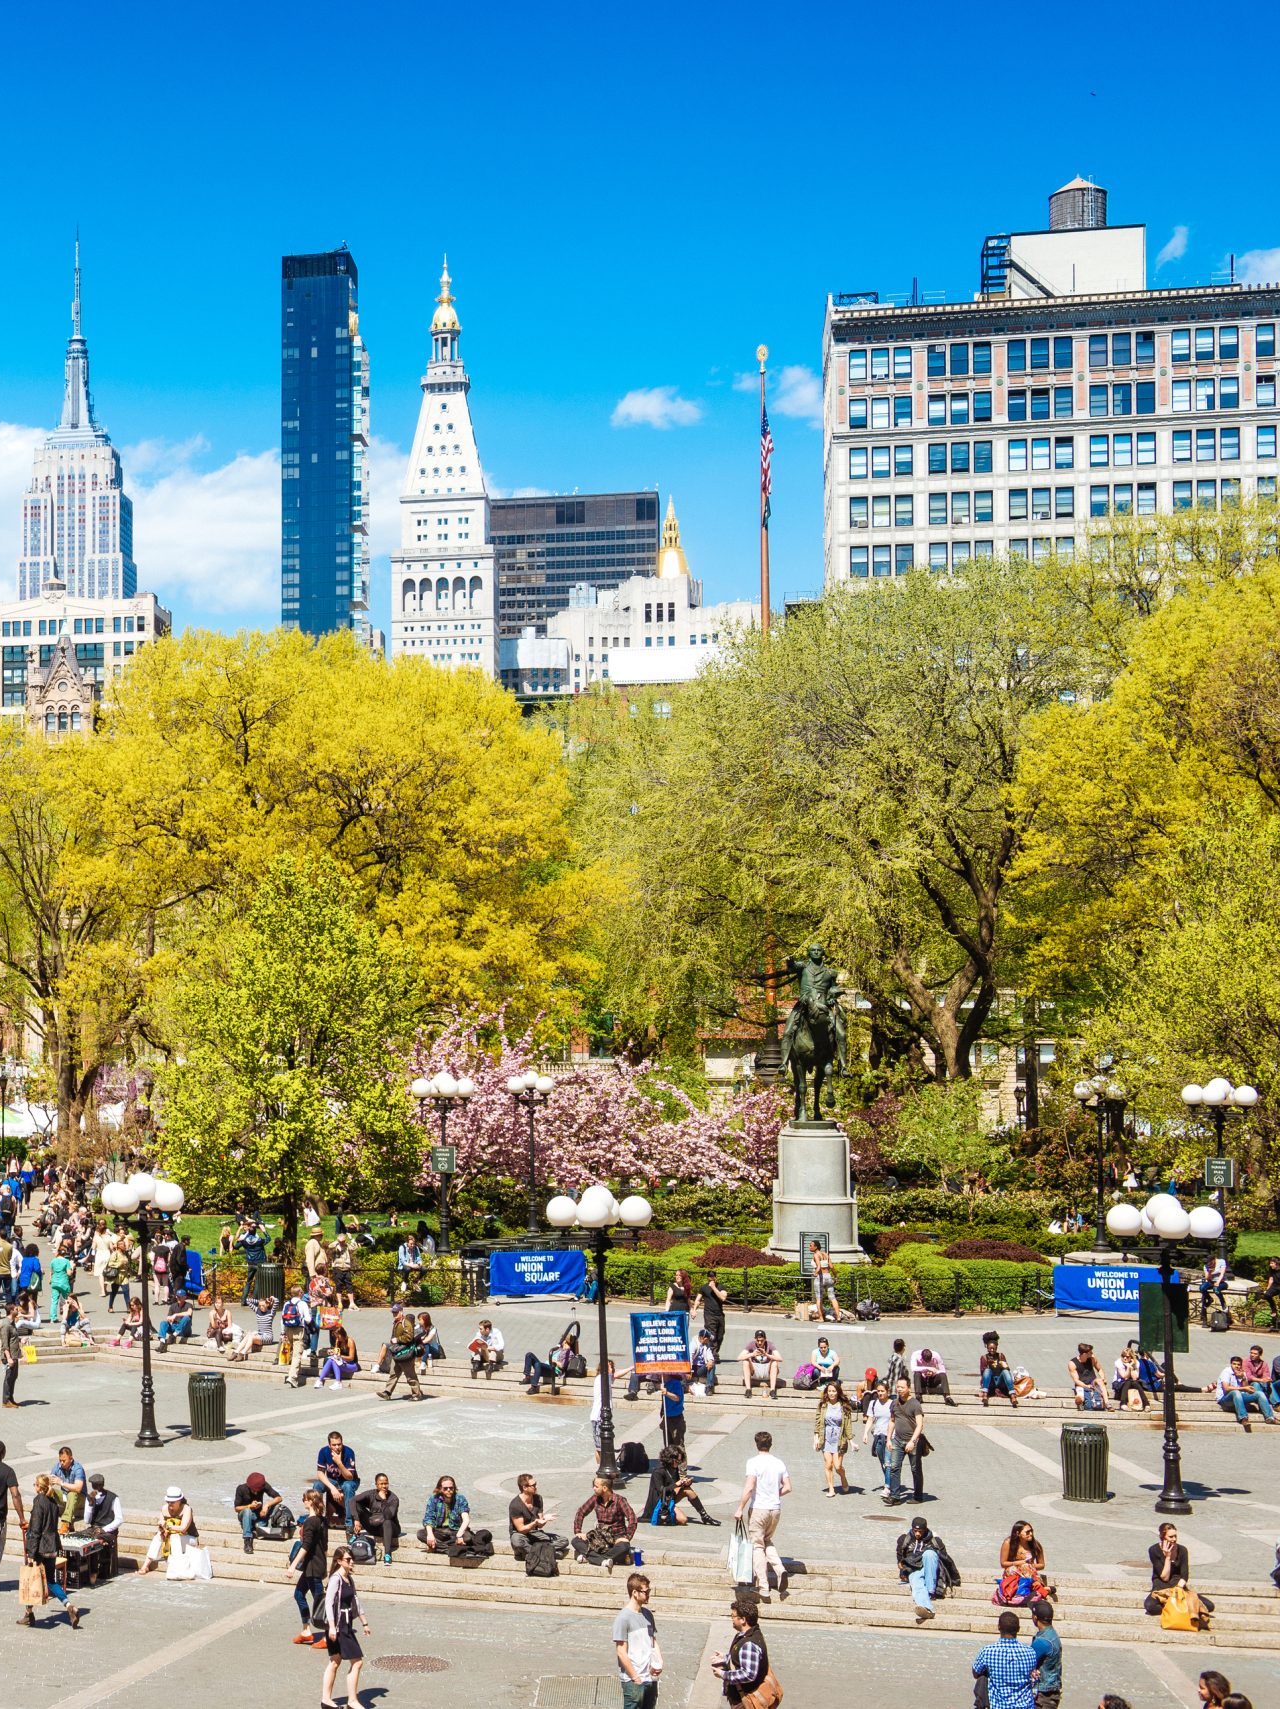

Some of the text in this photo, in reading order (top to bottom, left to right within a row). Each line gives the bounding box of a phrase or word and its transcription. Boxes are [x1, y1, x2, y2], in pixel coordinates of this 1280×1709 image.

[514, 1262, 544, 1273] UNION
[524, 1272, 561, 1284] SQUARE
[1129, 1271, 1139, 1279] TO
[1087, 1278, 1125, 1289] UNION
[1101, 1289, 1139, 1301] SQUAR
[639, 1336, 658, 1344] JESUS
[636, 1345, 648, 1353] AND
